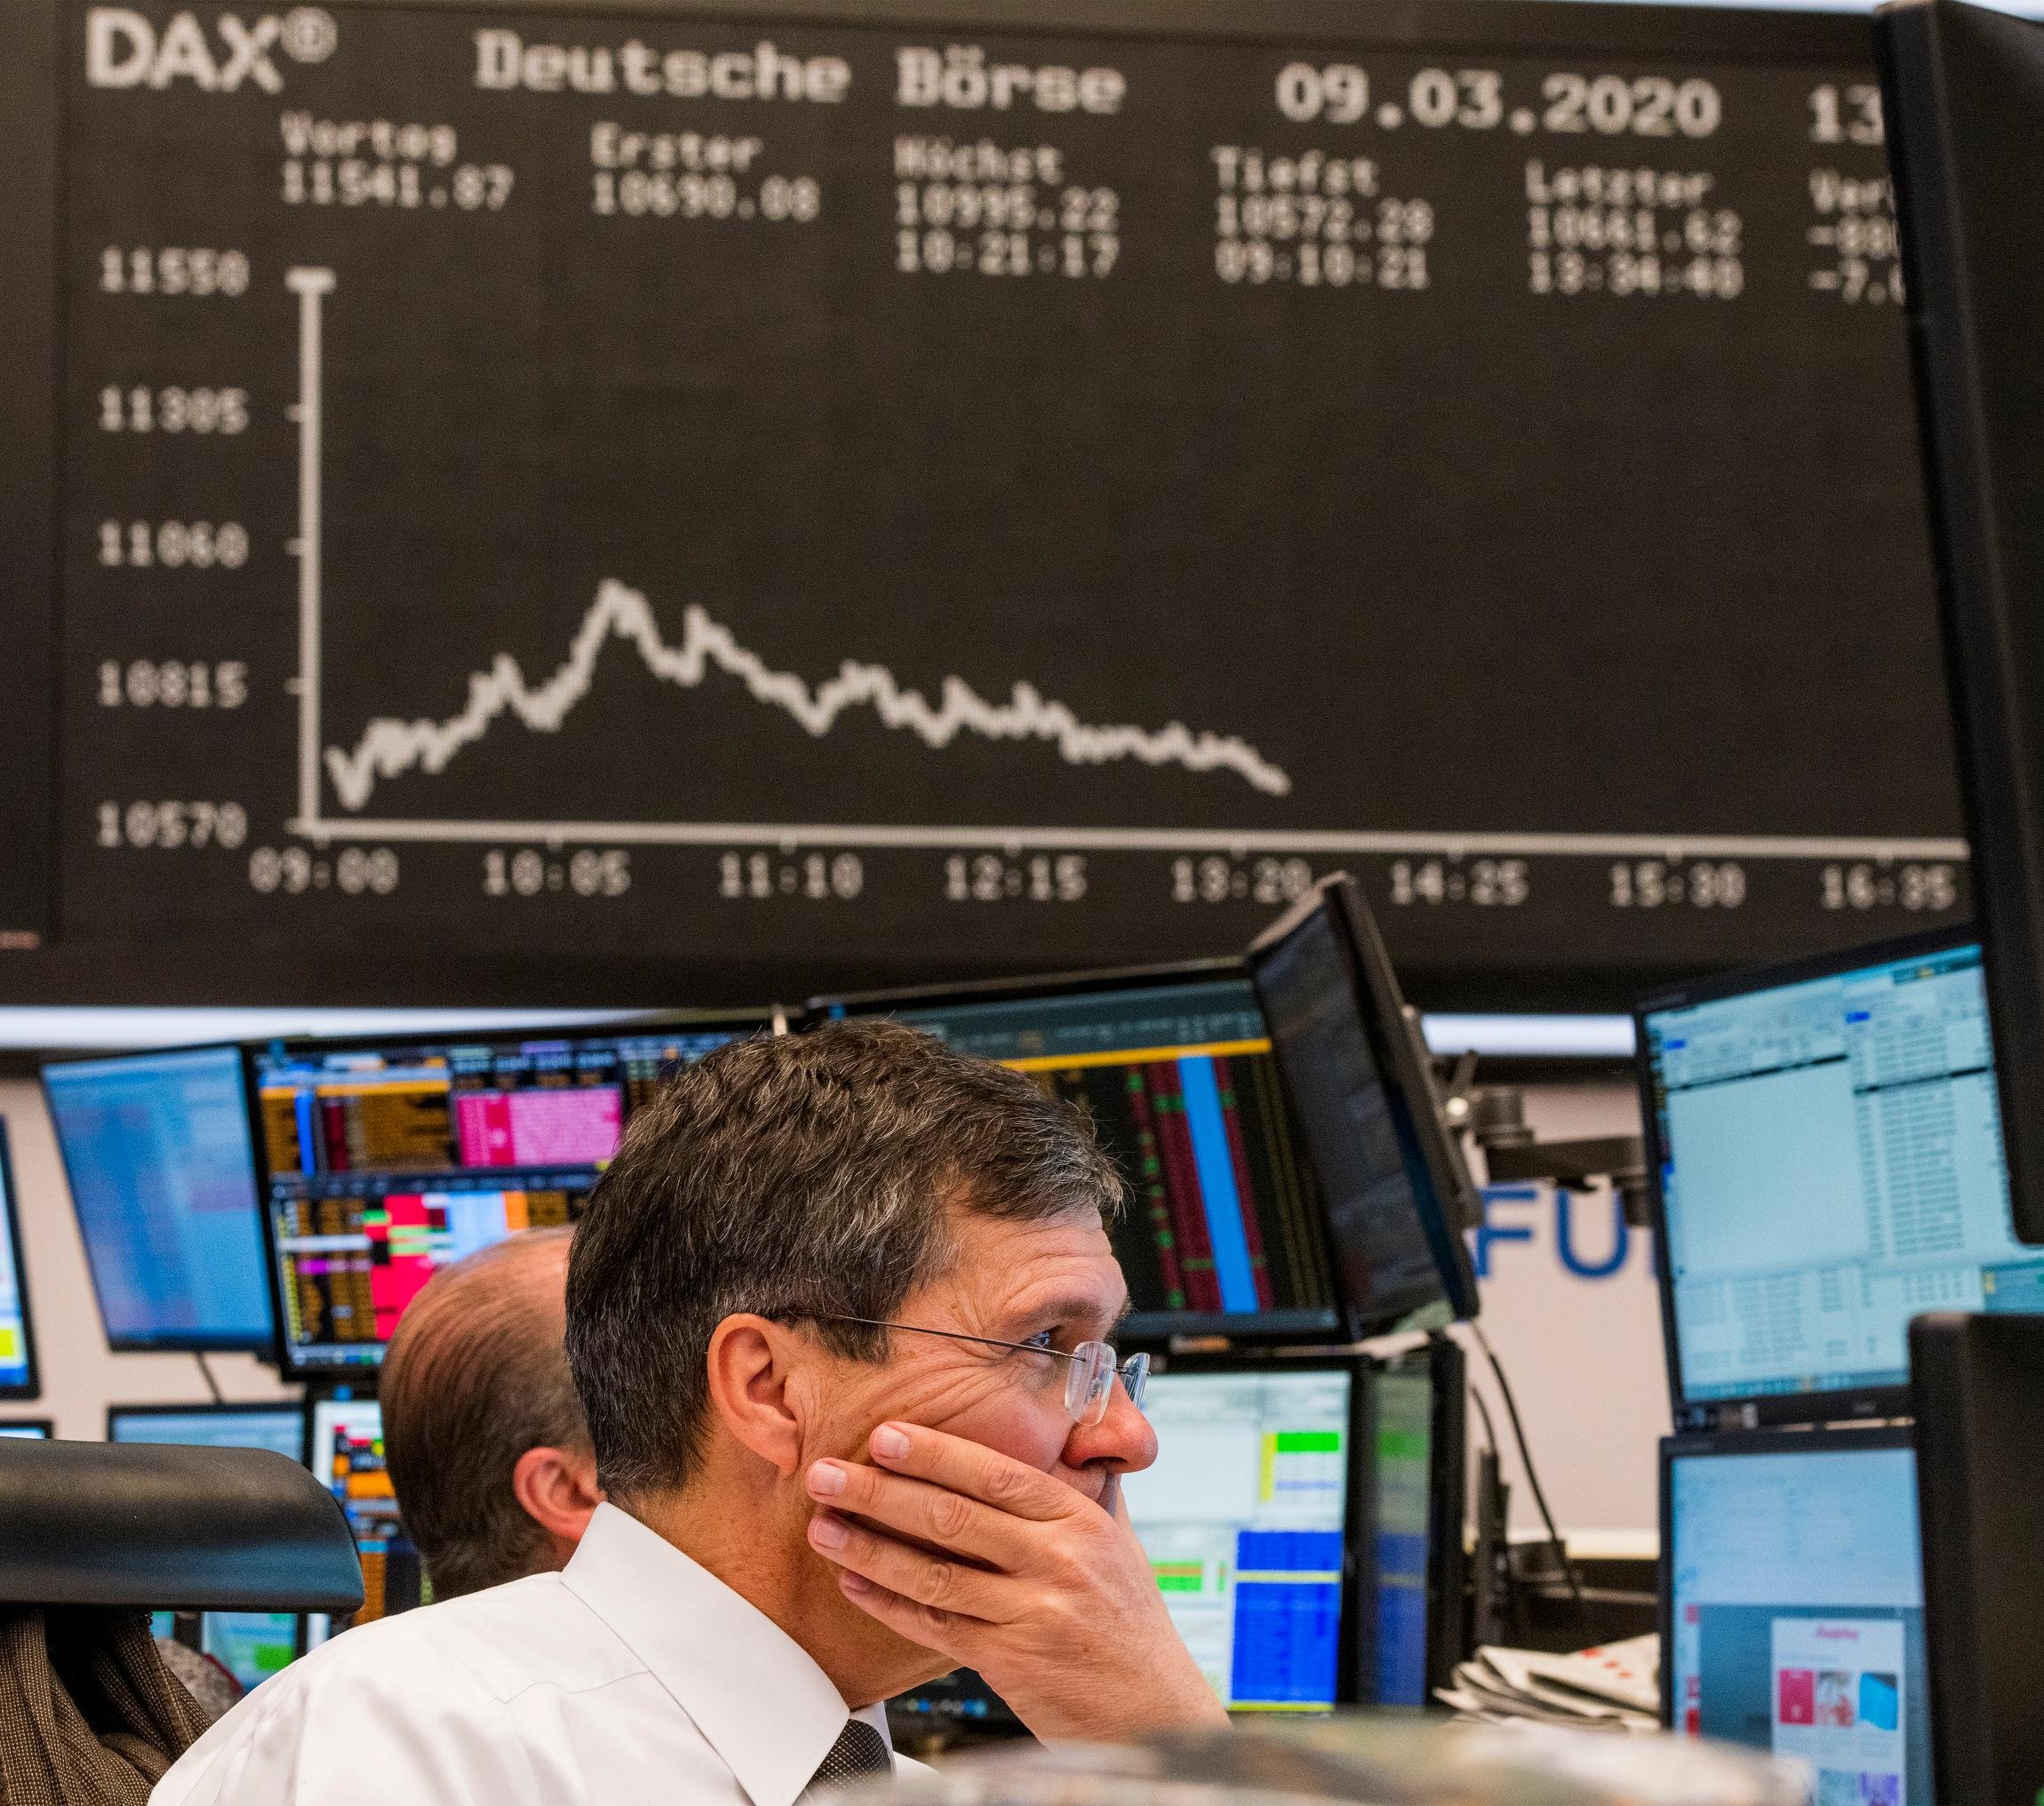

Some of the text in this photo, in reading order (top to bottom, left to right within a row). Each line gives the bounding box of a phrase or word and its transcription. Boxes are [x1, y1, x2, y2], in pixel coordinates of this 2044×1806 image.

[474, 28, 1127, 115] Deutsche Börse
[1274, 61, 1722, 138] 09.03.2020
[280, 111, 458, 167] Vortag
[589, 122, 763, 172] Erster
[894, 135, 1064, 185] Höchst
[282, 159, 515, 211] 11541.87
[592, 169, 821, 222] 10690.08
[1210, 145, 1379, 198] Tiefst
[1525, 158, 1714, 207] Letzter
[100, 245, 250, 296] 11550
[896, 228, 1121, 278] 10:21:17
[1214, 239, 1431, 291] 09:10:21
[99, 385, 250, 435] 11305
[98, 520, 250, 569] 11060
[98, 659, 248, 709] 10815
[97, 800, 248, 850] 10570
[249, 845, 399, 895] 09:00
[483, 850, 632, 897] 10:05
[719, 851, 865, 899] 11:10
[945, 853, 1088, 902] 12:15
[1391, 859, 1529, 907] 14:25
[1610, 862, 1747, 908] 15:30
[1820, 864, 1956, 911] 16:35
[1475, 1184, 1659, 1279] FU
